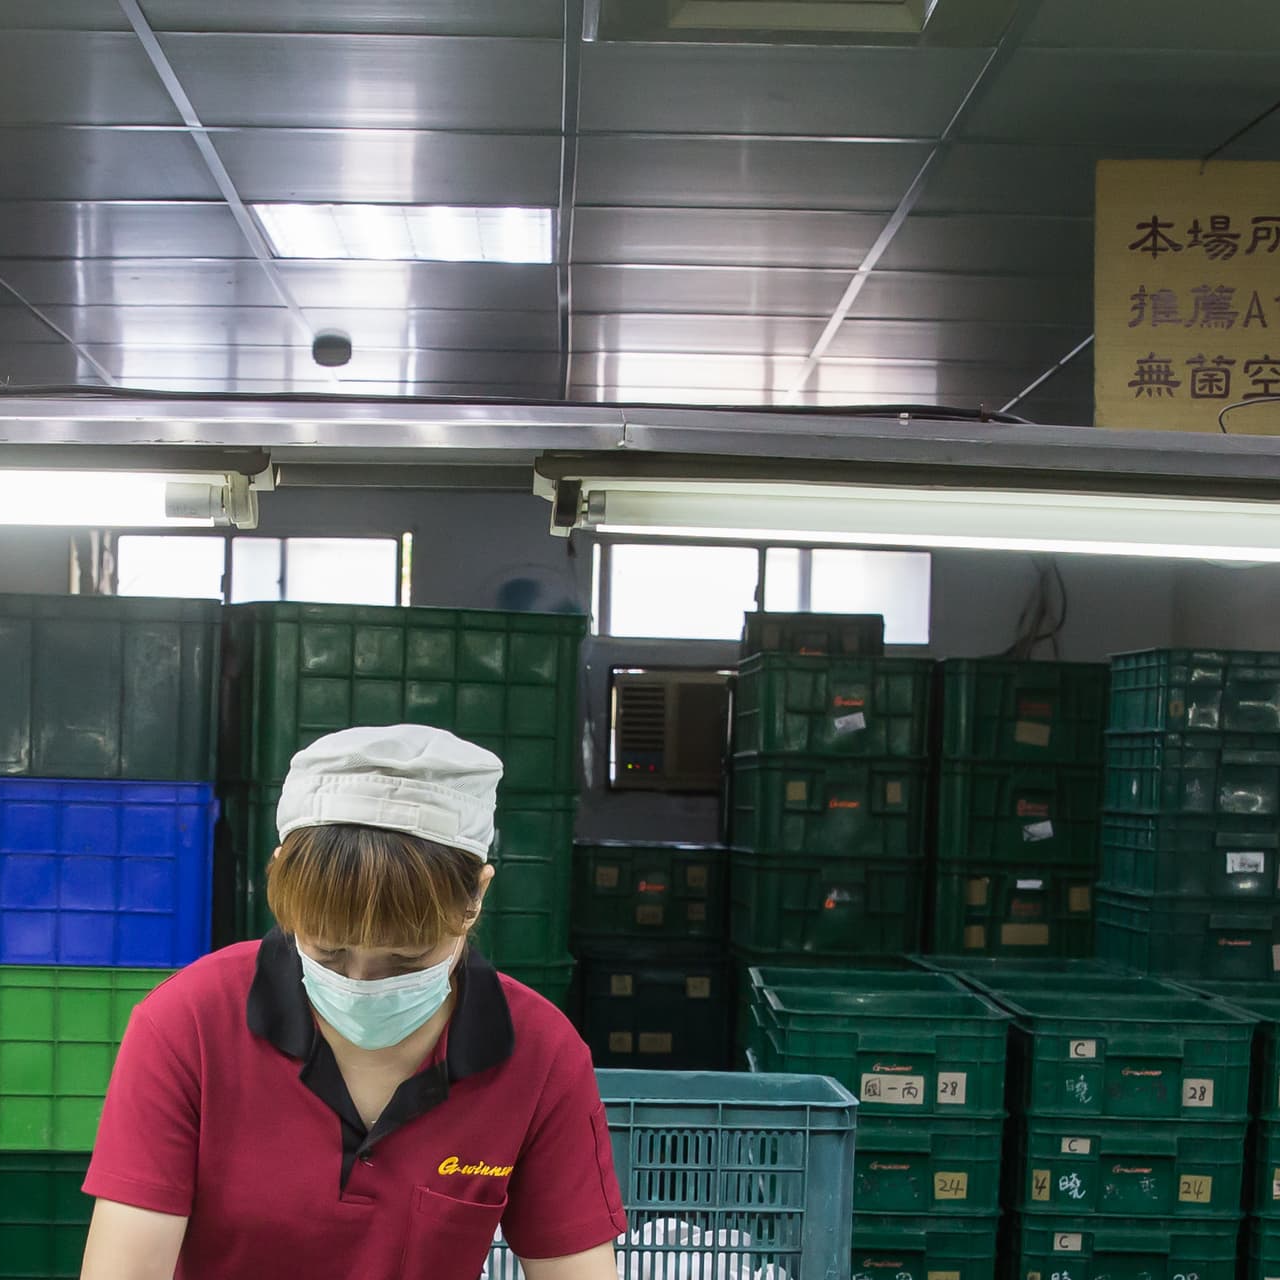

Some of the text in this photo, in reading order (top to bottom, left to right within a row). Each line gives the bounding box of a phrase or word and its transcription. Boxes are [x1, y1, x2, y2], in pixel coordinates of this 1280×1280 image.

[1074, 1042, 1087, 1057] C
[939, 1080, 959, 1097] 28
[1186, 1085, 1207, 1102] 28
[938, 1178, 964, 1196] 24
[1180, 1181, 1203, 1199] 24
